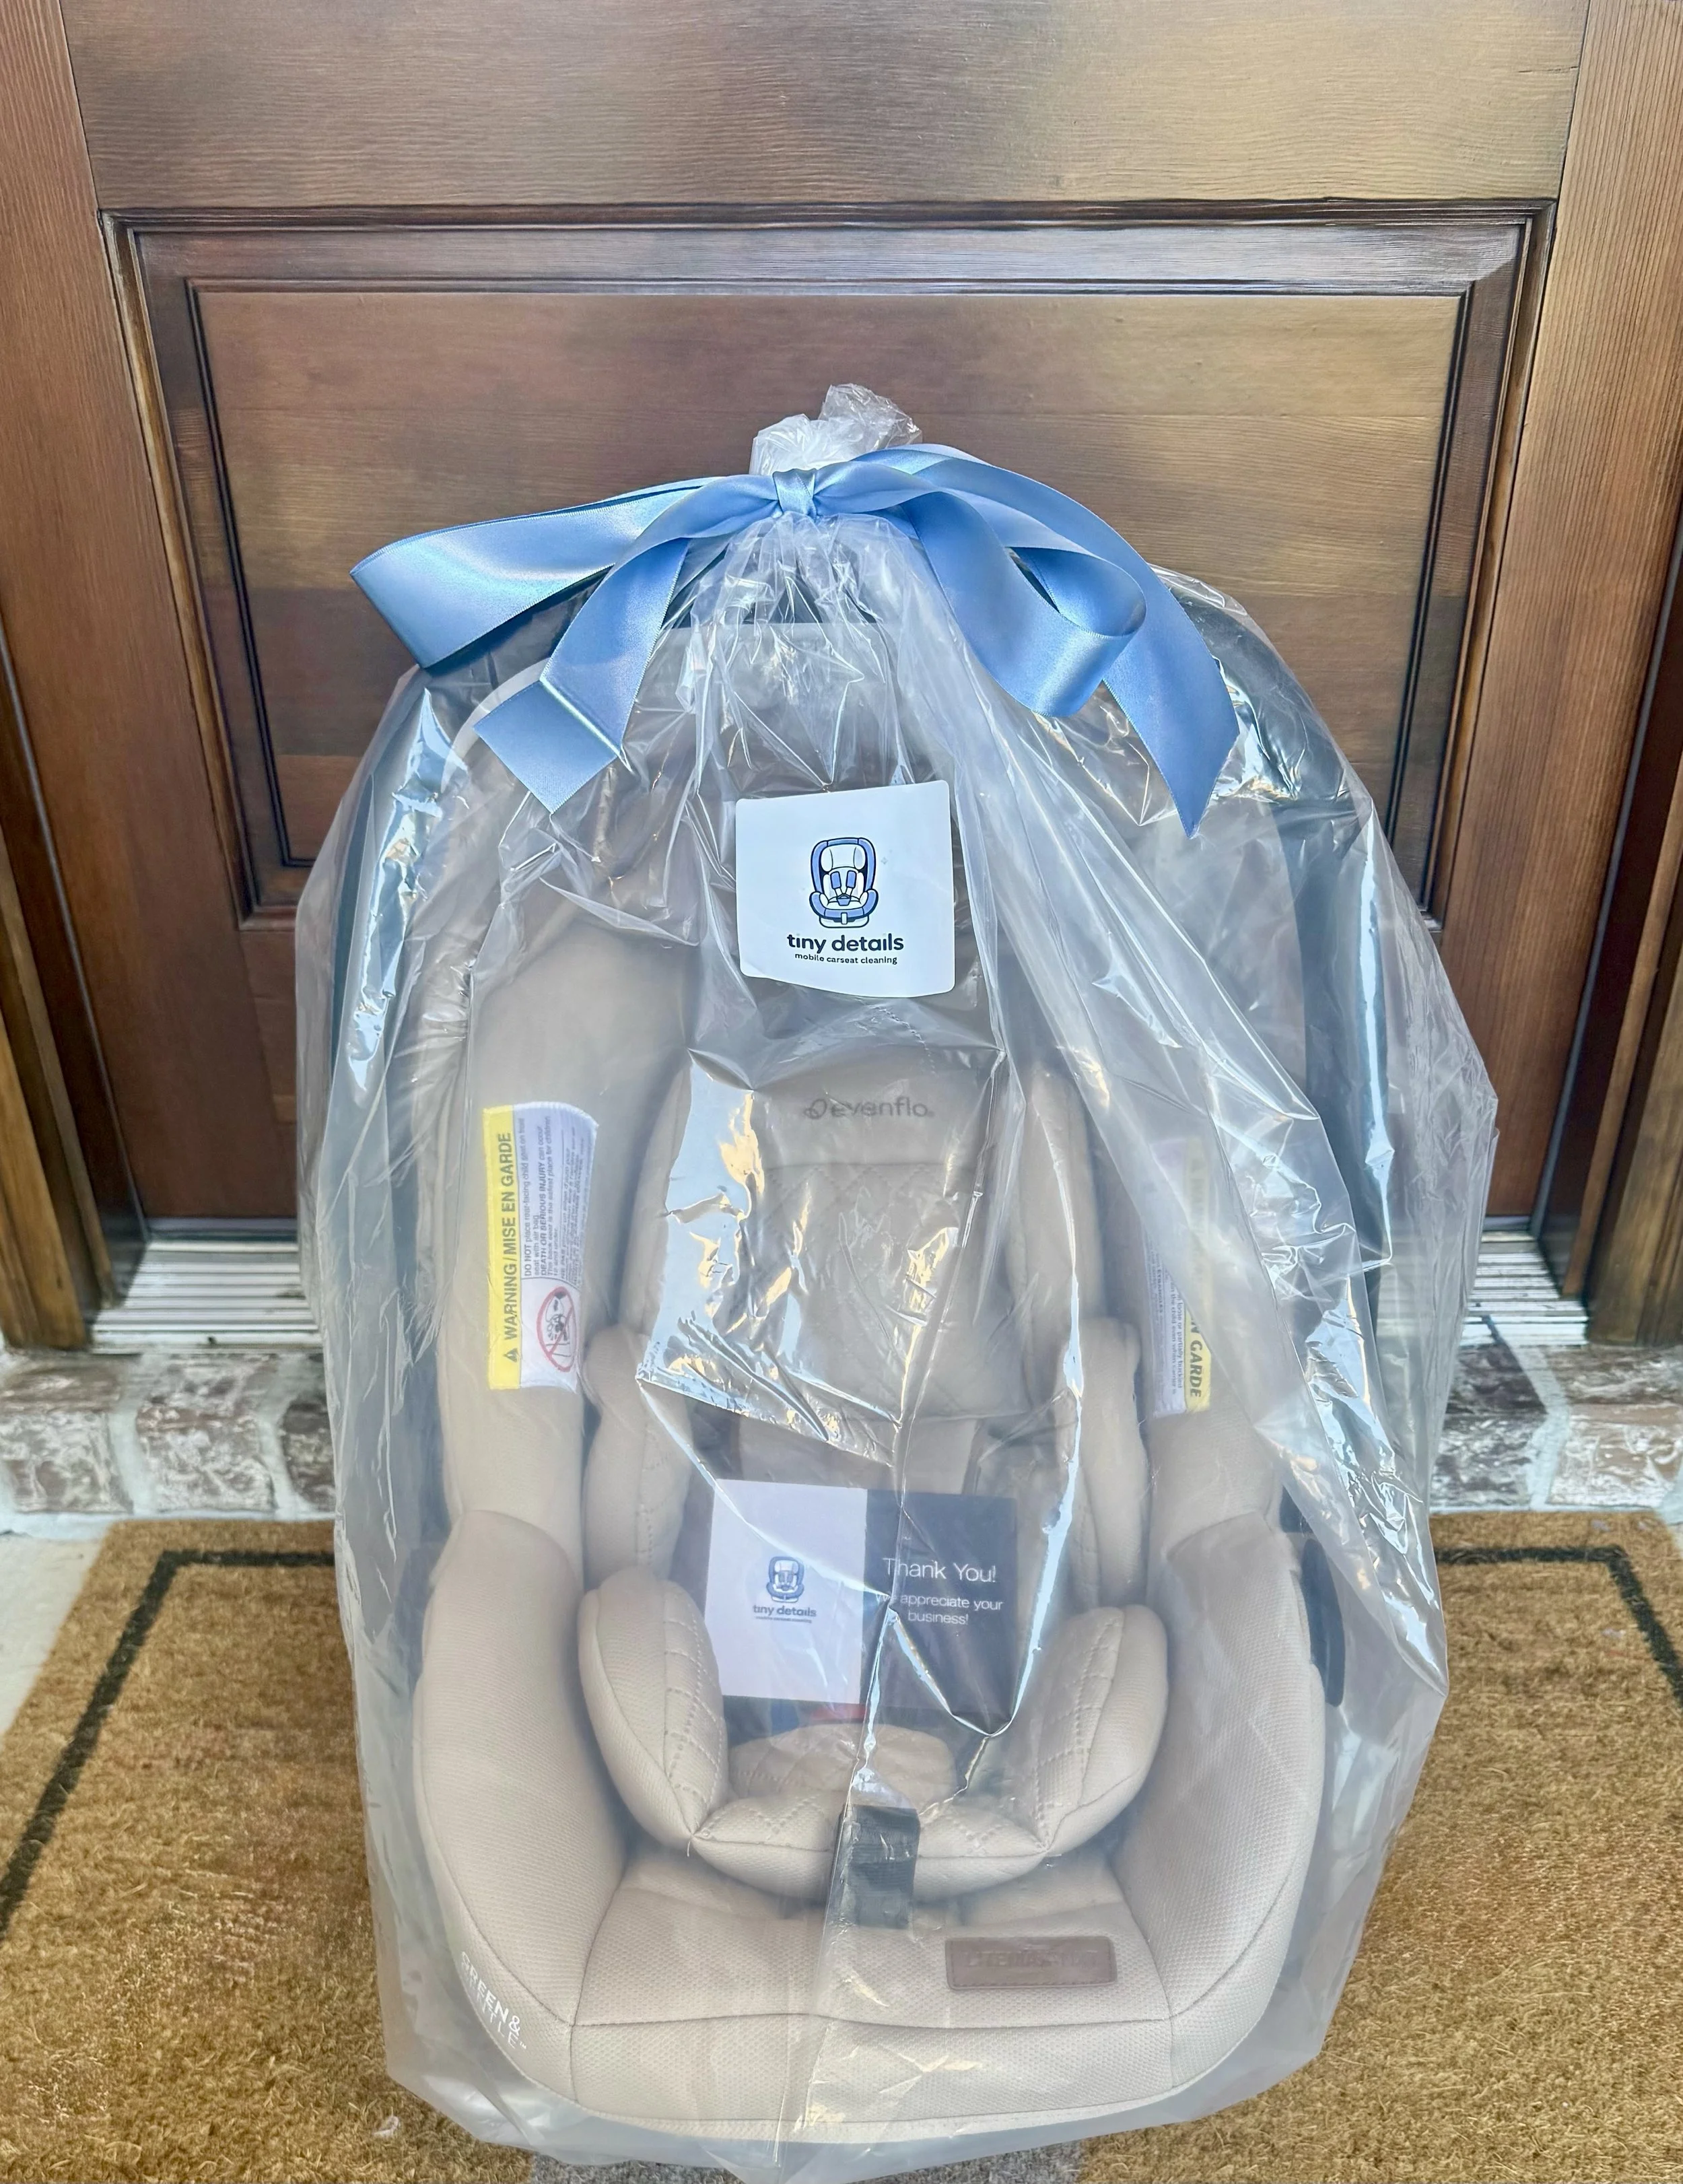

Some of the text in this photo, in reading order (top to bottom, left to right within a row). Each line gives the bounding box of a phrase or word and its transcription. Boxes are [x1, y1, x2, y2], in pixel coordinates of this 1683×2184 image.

[787, 933, 904, 953] tiny details
[795, 953, 824, 961] mobile
[860, 956, 897, 965] cleaning
[498, 1132, 514, 1186] GARDE
[521, 1163, 529, 1180] child
[538, 1161, 547, 1192] INJURY
[502, 1192, 516, 1213] EN
[539, 1193, 547, 1231] SERIOUS
[539, 1233, 547, 1245] OR
[524, 1244, 532, 1262] NOT
[524, 1264, 532, 1276] DO
[1189, 1340, 1203, 1398] GARDE
[882, 1557, 996, 1583] Thank You!
[753, 1605, 817, 1617] tiny details
[900, 1594, 970, 1609] appreciate
[973, 1600, 1004, 1612] your
[907, 1610, 969, 1625] business!
